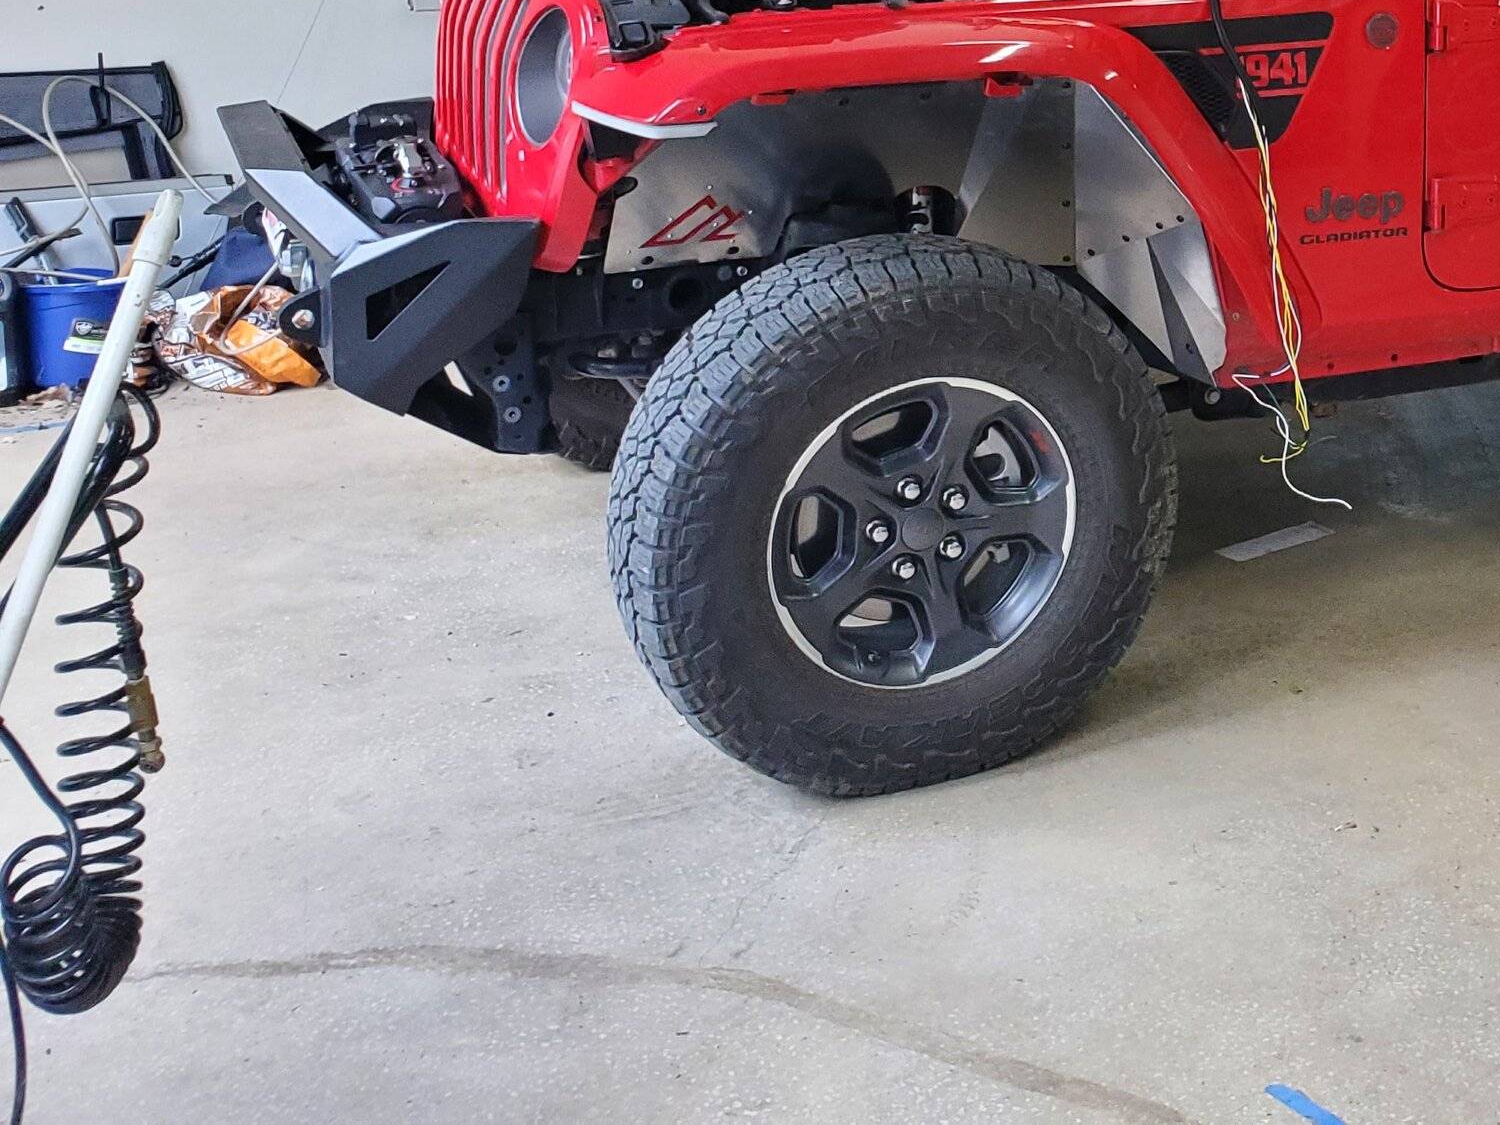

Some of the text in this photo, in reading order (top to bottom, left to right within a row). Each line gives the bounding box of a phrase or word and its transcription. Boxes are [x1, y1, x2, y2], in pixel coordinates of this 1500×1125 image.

[1236, 51, 1308, 88] 941
[1305, 187, 1404, 224] Jeep
[1299, 227, 1408, 245] GLADIATOR
